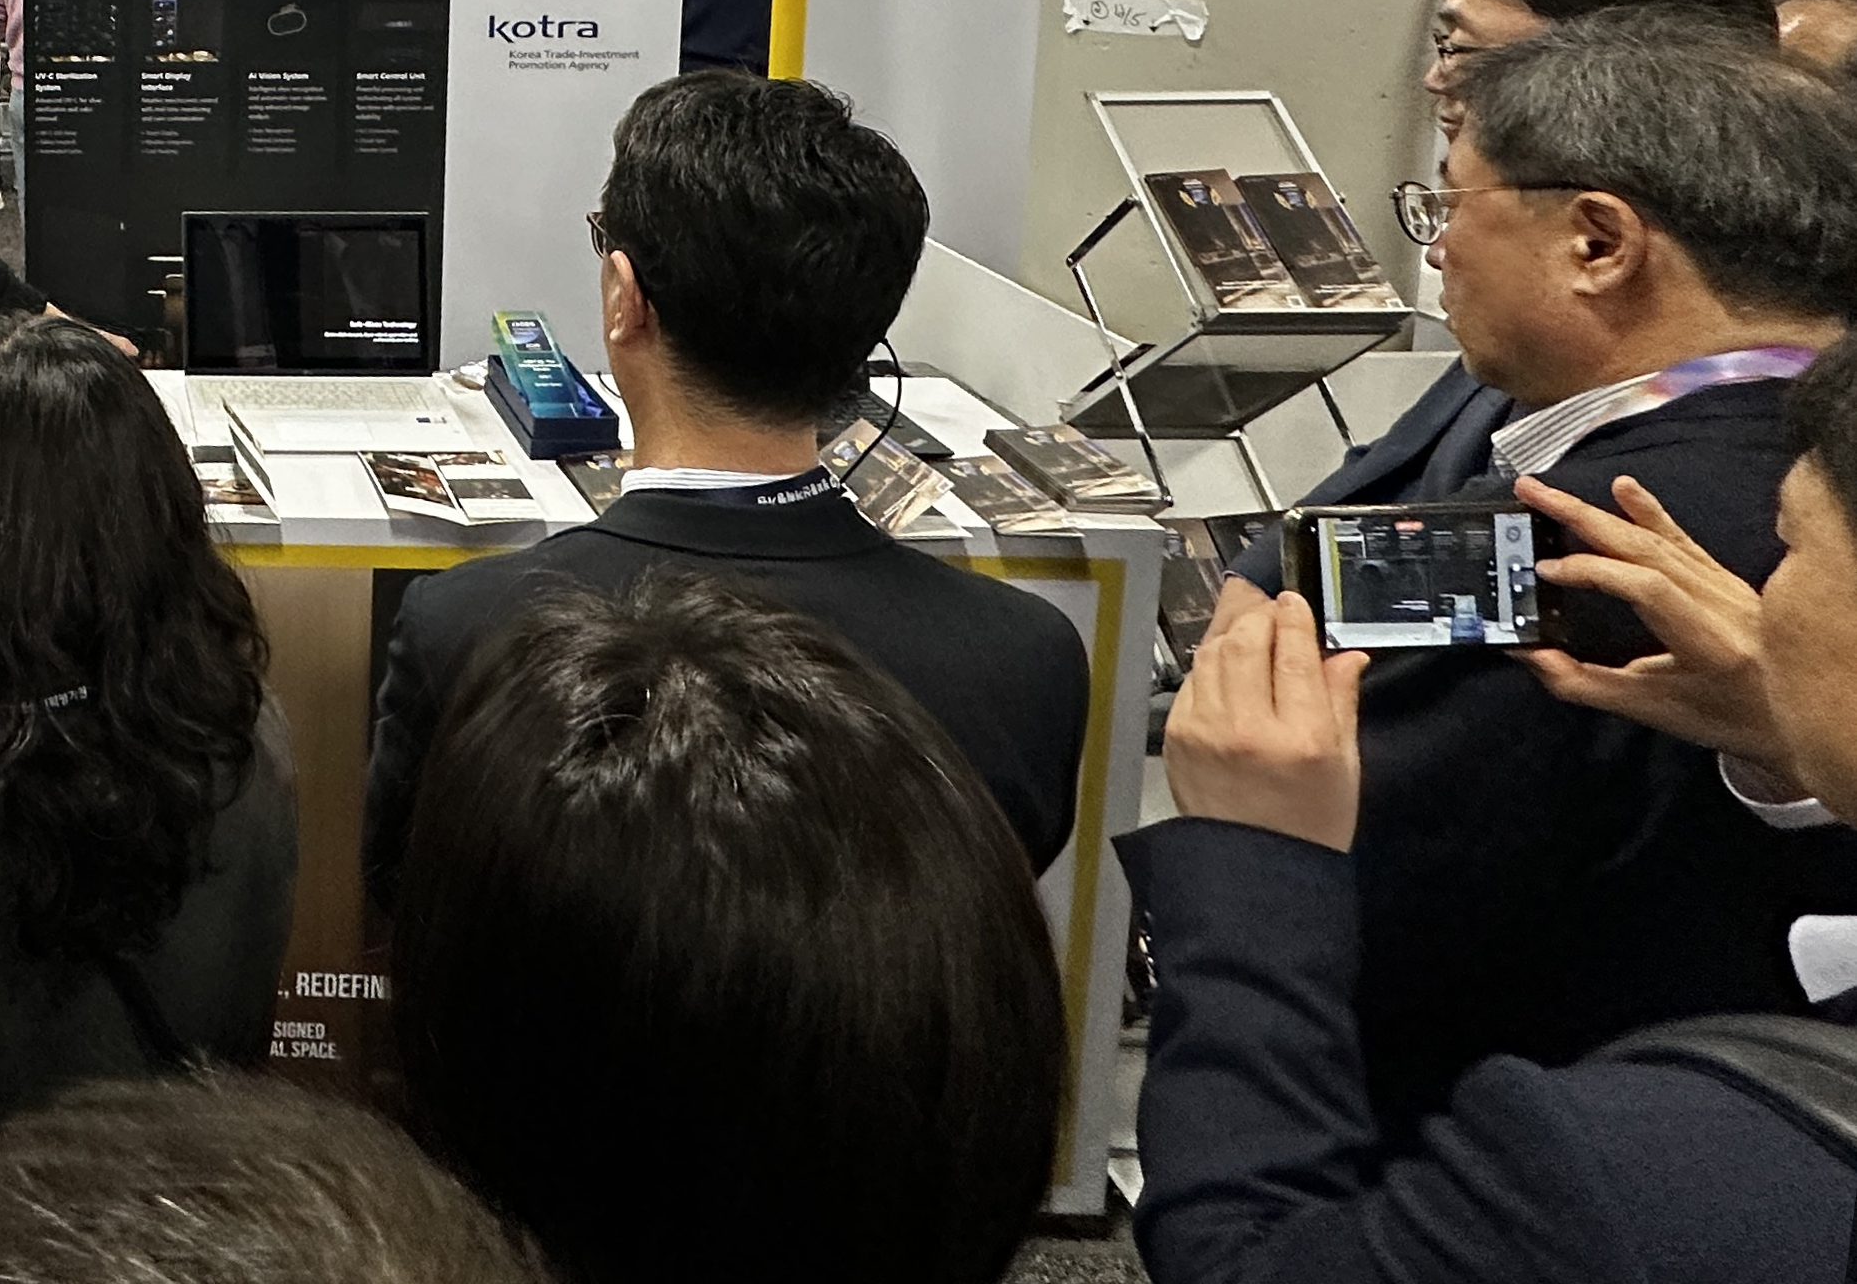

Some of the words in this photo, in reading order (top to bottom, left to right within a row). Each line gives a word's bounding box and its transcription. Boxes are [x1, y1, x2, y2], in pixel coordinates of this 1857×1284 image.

[488, 15, 599, 44] kotra
[509, 50, 541, 59] Korea
[544, 50, 640, 60] Trade-Investment
[509, 61, 567, 70] Promotion
[569, 61, 610, 72] Agency
